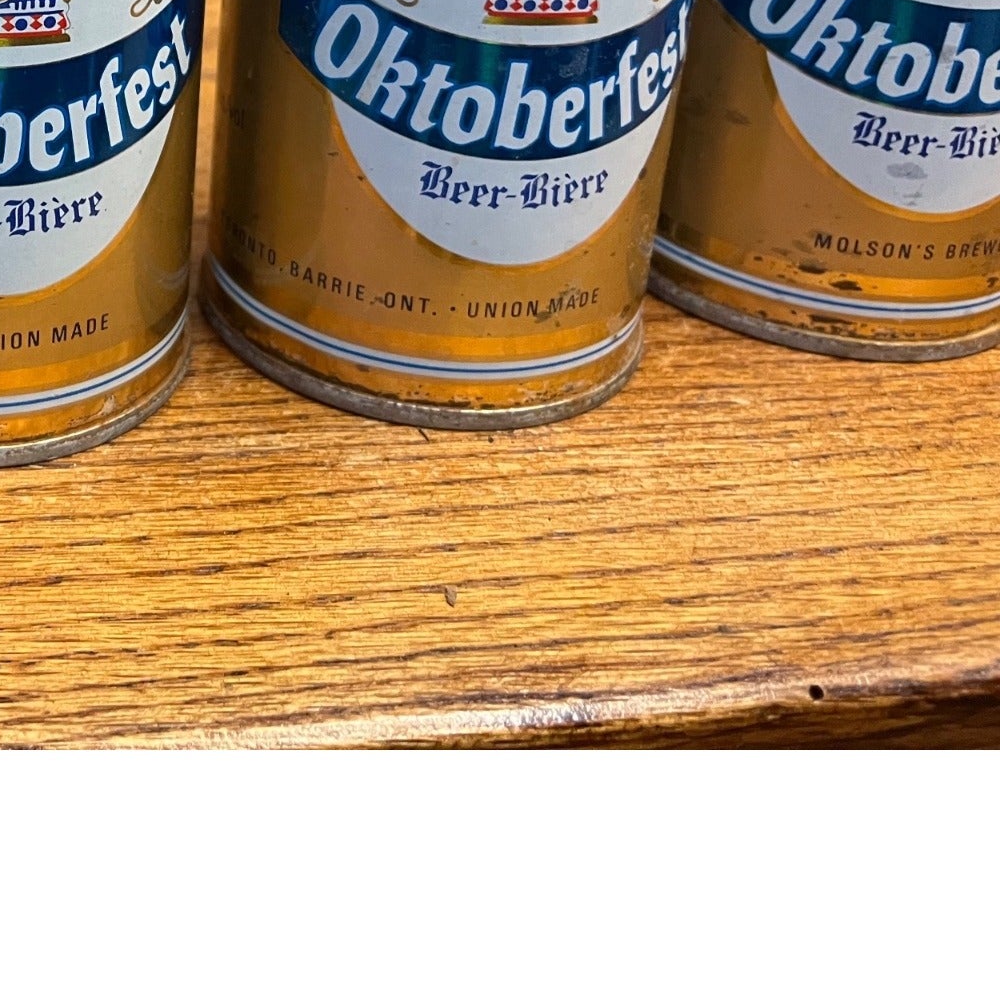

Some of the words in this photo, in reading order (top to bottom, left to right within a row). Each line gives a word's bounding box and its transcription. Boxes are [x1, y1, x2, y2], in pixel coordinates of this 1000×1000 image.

[418, 160, 609, 210] Beer-Bière
[812, 232, 936, 260] MOLSON'S
[945, 239, 1000, 260] BREW
[383, 292, 438, 317] ONT.
[466, 300, 540, 319] UNION
[550, 286, 600, 315] MADE
[51, 311, 110, 344] MADE
